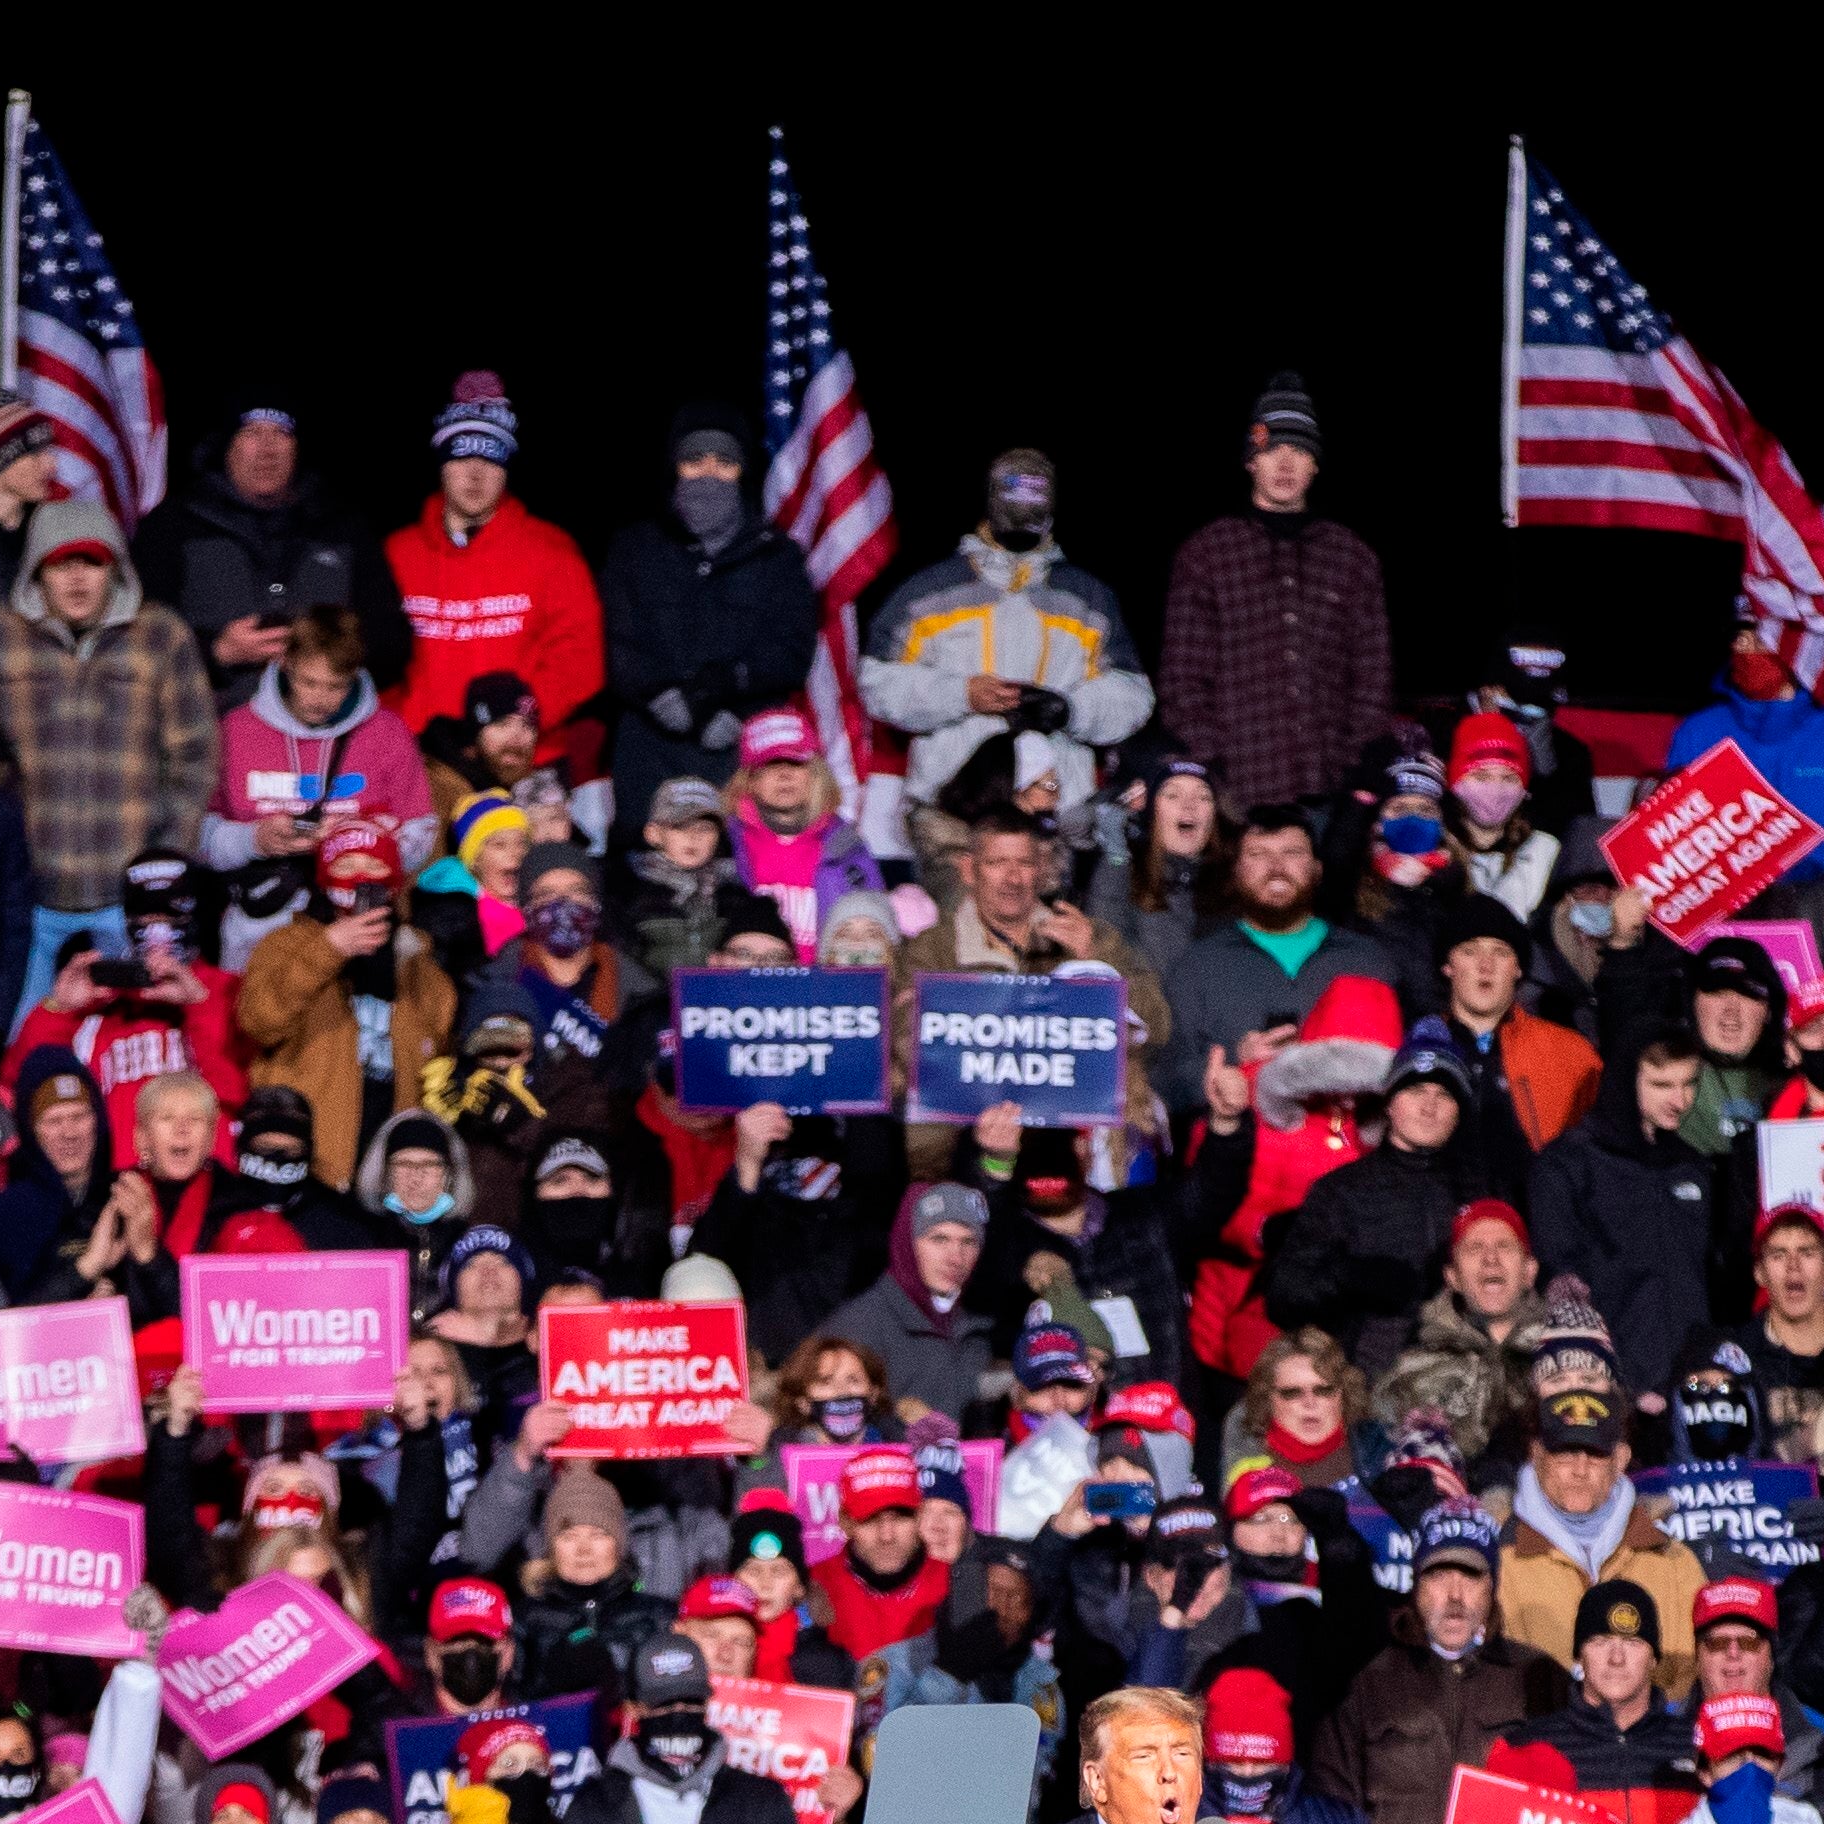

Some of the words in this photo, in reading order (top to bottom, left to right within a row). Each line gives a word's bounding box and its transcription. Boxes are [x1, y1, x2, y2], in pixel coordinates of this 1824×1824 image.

[1648, 788, 1716, 850] MAKE
[1636, 786, 1779, 908] AMERICA
[1656, 857, 1731, 927] GREAT
[1723, 809, 1802, 873] AGAIN
[681, 1005, 881, 1040] PROMISES
[920, 1012, 1118, 1051] PROMISES
[729, 1042, 833, 1078] KEPT
[960, 1054, 1075, 1086] MADE
[211, 1299, 381, 1344] Women
[608, 1327, 689, 1353] MAKE
[226, 1347, 278, 1366] FOR
[285, 1346, 366, 1366] TRUMP
[552, 1356, 738, 1394] AMERICA
[570, 1402, 652, 1428] REAT
[1671, 1481, 1754, 1506] MAKE
[26, 1585, 106, 1609] TRUMP
[163, 1599, 313, 1701] Women
[205, 1676, 252, 1713] FOR
[254, 1635, 311, 1686] TRUMP
